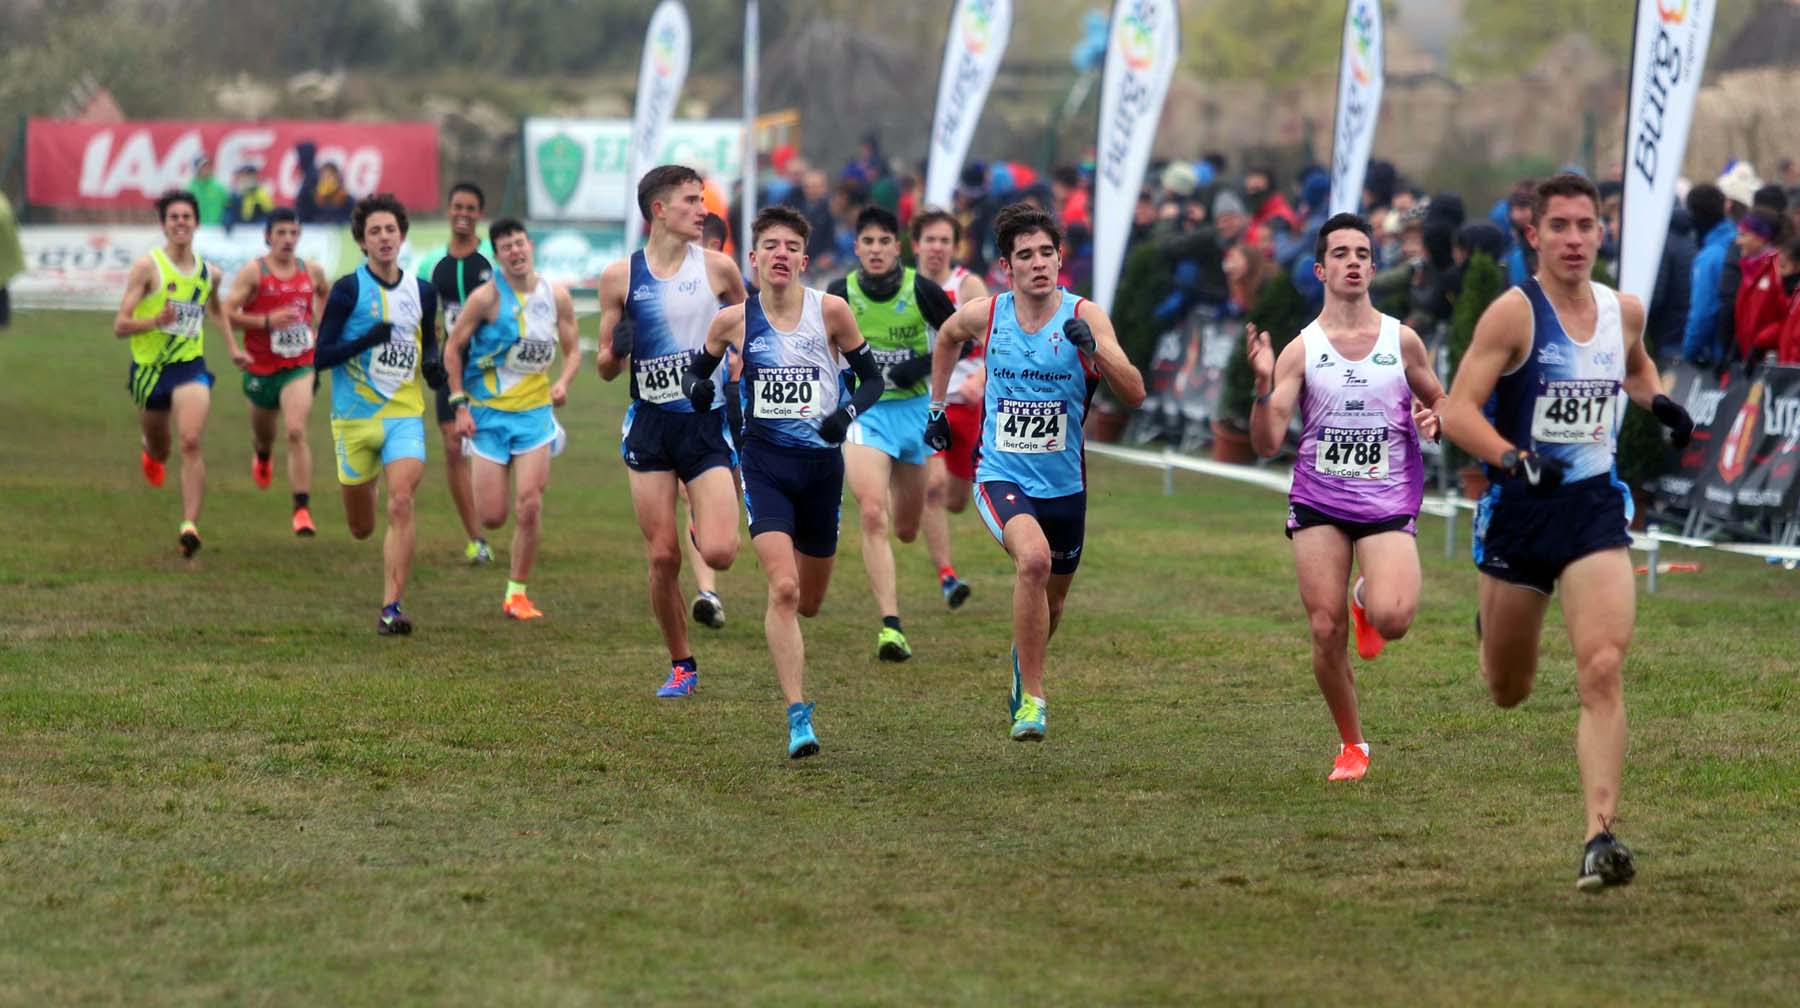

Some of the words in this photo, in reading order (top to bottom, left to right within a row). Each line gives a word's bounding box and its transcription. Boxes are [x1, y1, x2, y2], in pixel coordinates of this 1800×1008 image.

[758, 367, 813, 375] DIPUTACIÓN
[761, 381, 812, 404] 4820
[1003, 400, 1061, 409] DIPUTACIÓN
[1003, 406, 1061, 416] BURGOS
[1545, 397, 1609, 425] 4817
[1004, 415, 1059, 438] 4724
[1324, 427, 1384, 436] DIPUTACIÓN
[1324, 434, 1384, 442] BURGOS
[1324, 443, 1381, 465] 4788
